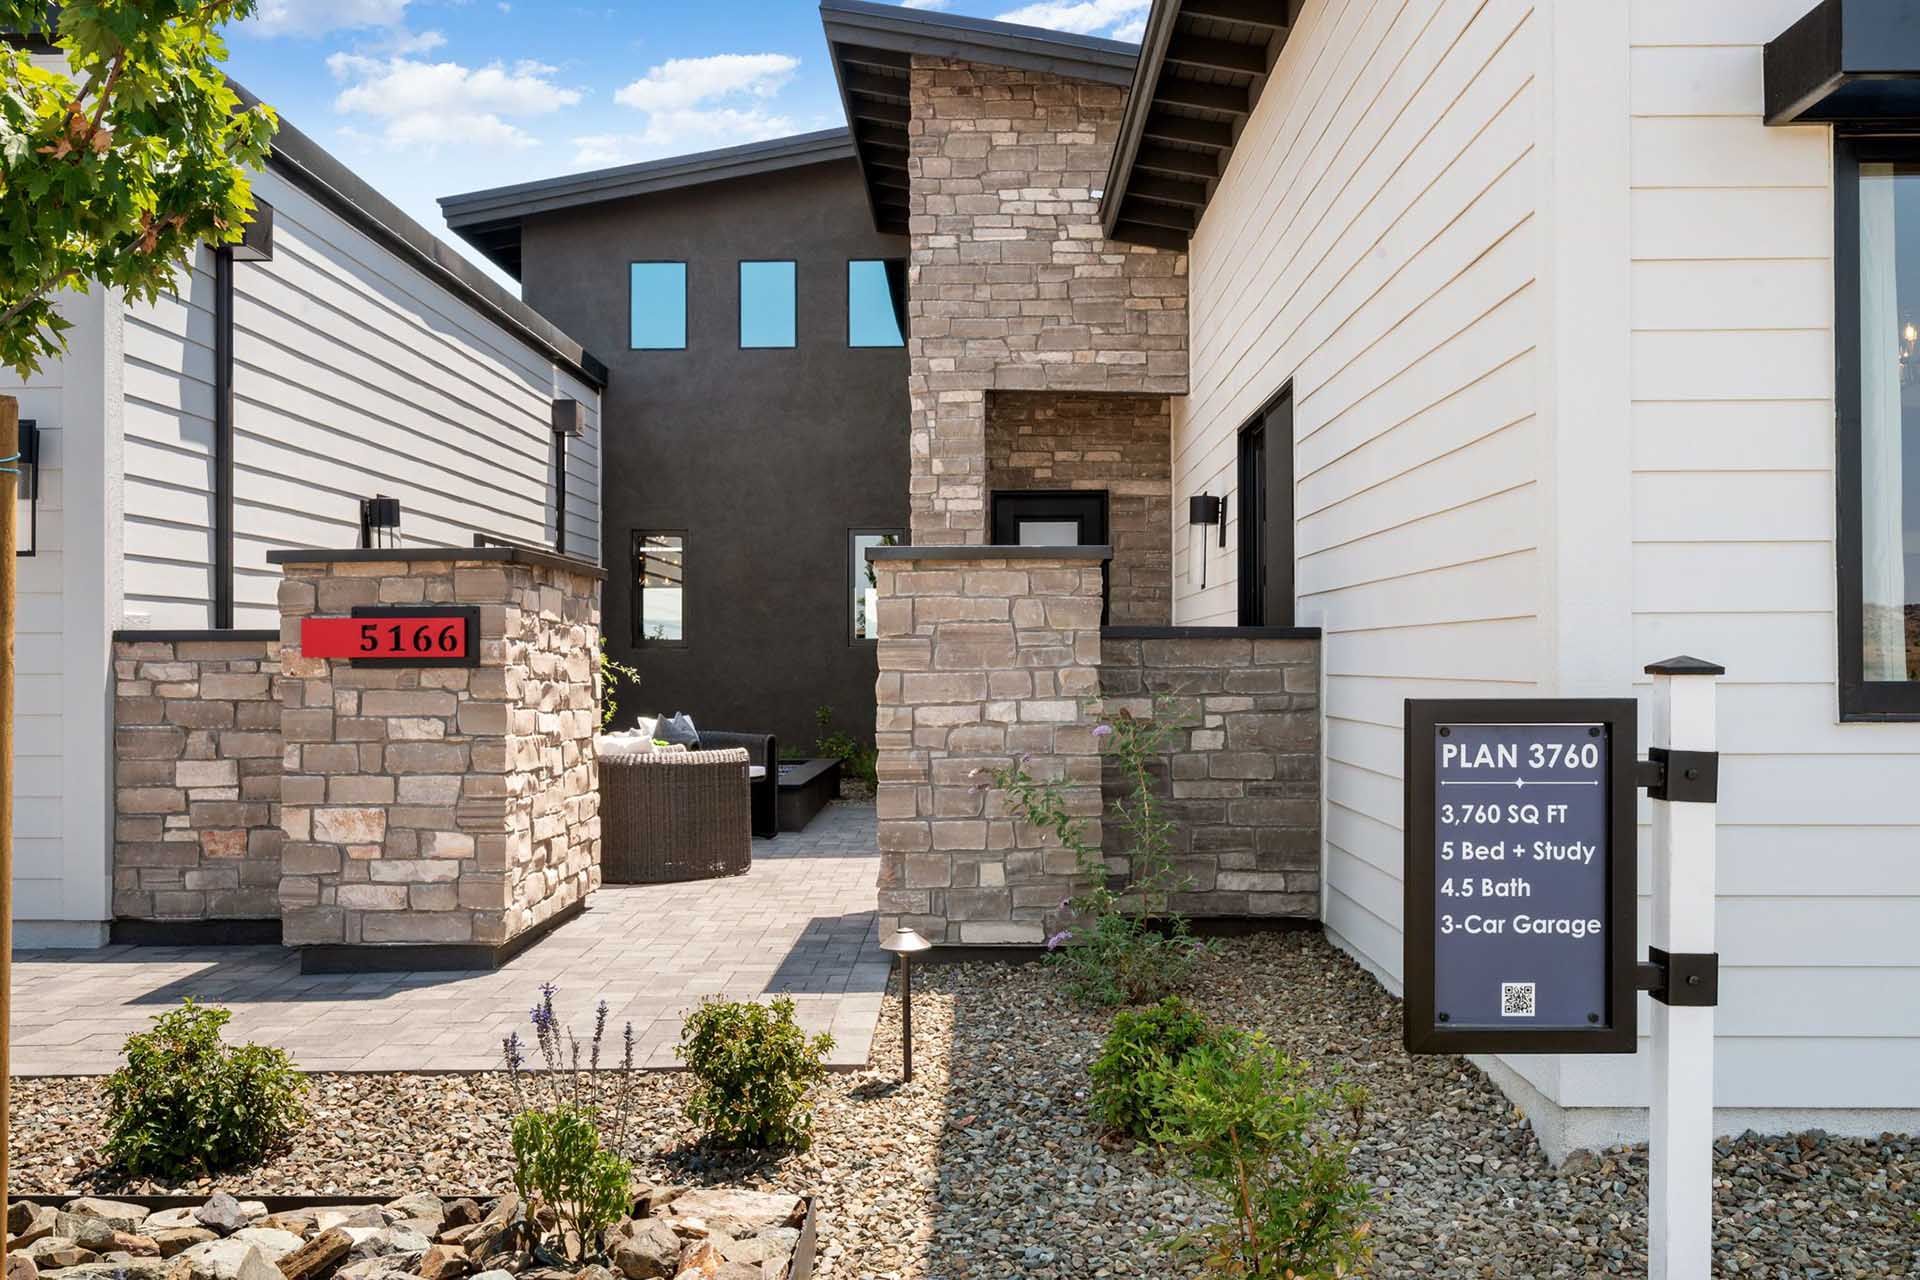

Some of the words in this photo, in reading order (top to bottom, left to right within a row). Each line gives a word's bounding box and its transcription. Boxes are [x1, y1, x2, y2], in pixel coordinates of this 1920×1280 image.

[360, 624, 457, 652] 5166
[1442, 743, 1518, 768] PLAN
[1528, 743, 1598, 769] 3760
[1441, 804, 1501, 826] 3,760
[1507, 804, 1539, 825] SQ
[1547, 805, 1567, 824] FT
[1441, 842, 1454, 860] 5
[1461, 841, 1505, 860] Bed
[1512, 844, 1526, 858] +
[1533, 841, 1596, 864] Study
[1440, 879, 1474, 897] 4.5
[1481, 878, 1531, 897] Bath
[1441, 915, 1506, 934] 3-Car
[1513, 915, 1602, 938] Garage
